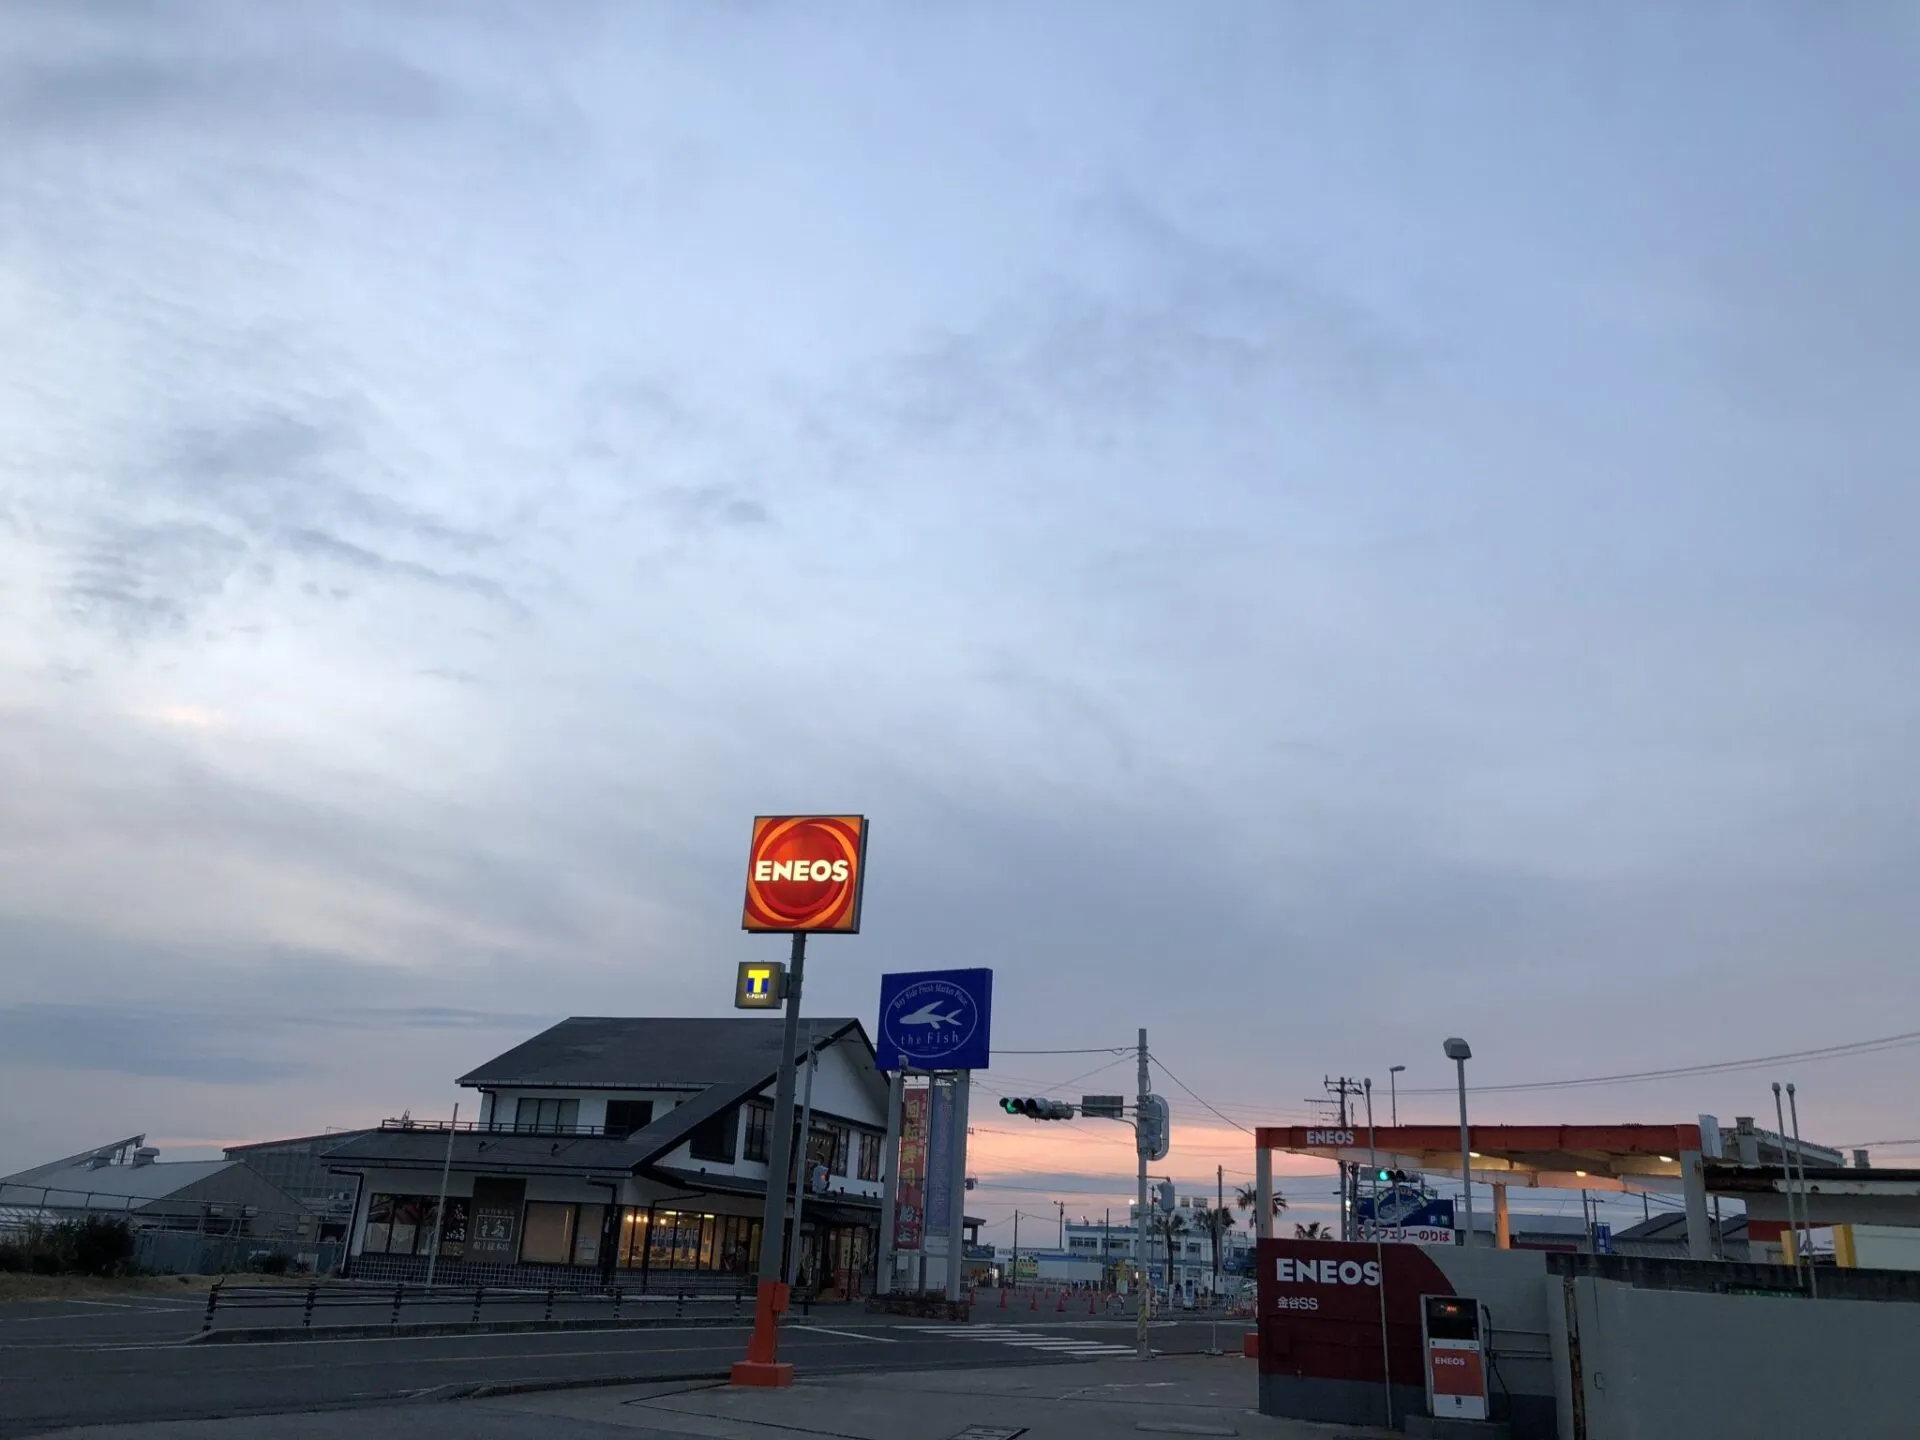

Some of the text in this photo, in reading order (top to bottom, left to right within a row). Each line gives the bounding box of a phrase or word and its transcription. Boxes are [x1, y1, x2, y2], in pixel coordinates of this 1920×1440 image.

[755, 859, 849, 882] ENEOS
[747, 969, 770, 994] T
[894, 996, 906, 1009] Bay
[918, 984, 934, 995] Fresh
[935, 984, 955, 994] Market
[901, 1030, 959, 1045] the Fish
[1306, 1130, 1355, 1145] ENEOS
[1276, 1258, 1380, 1286] ENEOS
[1277, 1296, 1320, 1310] 金谷SS
[1434, 1357, 1465, 1366] ENEOS
